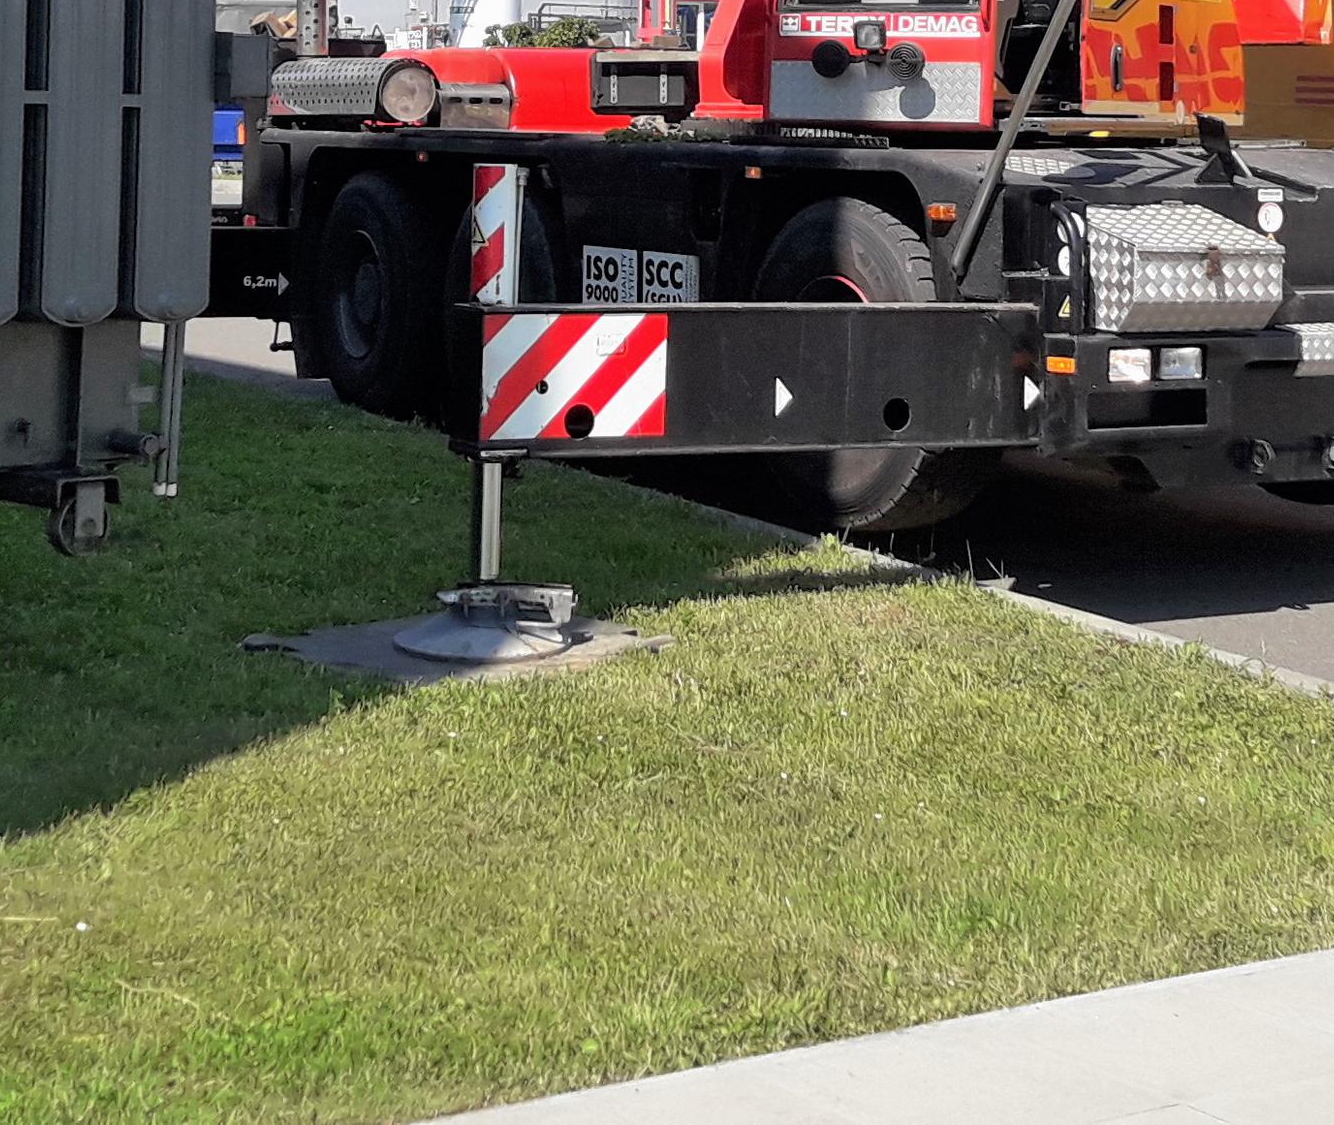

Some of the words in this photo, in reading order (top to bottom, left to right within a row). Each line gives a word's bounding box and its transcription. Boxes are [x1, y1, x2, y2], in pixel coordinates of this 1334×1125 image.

[898, 16, 978, 32] DEMAG
[586, 255, 619, 282] ISO
[645, 258, 684, 290] SCC
[243, 275, 277, 289] 6,2m
[586, 283, 619, 303] 9000
